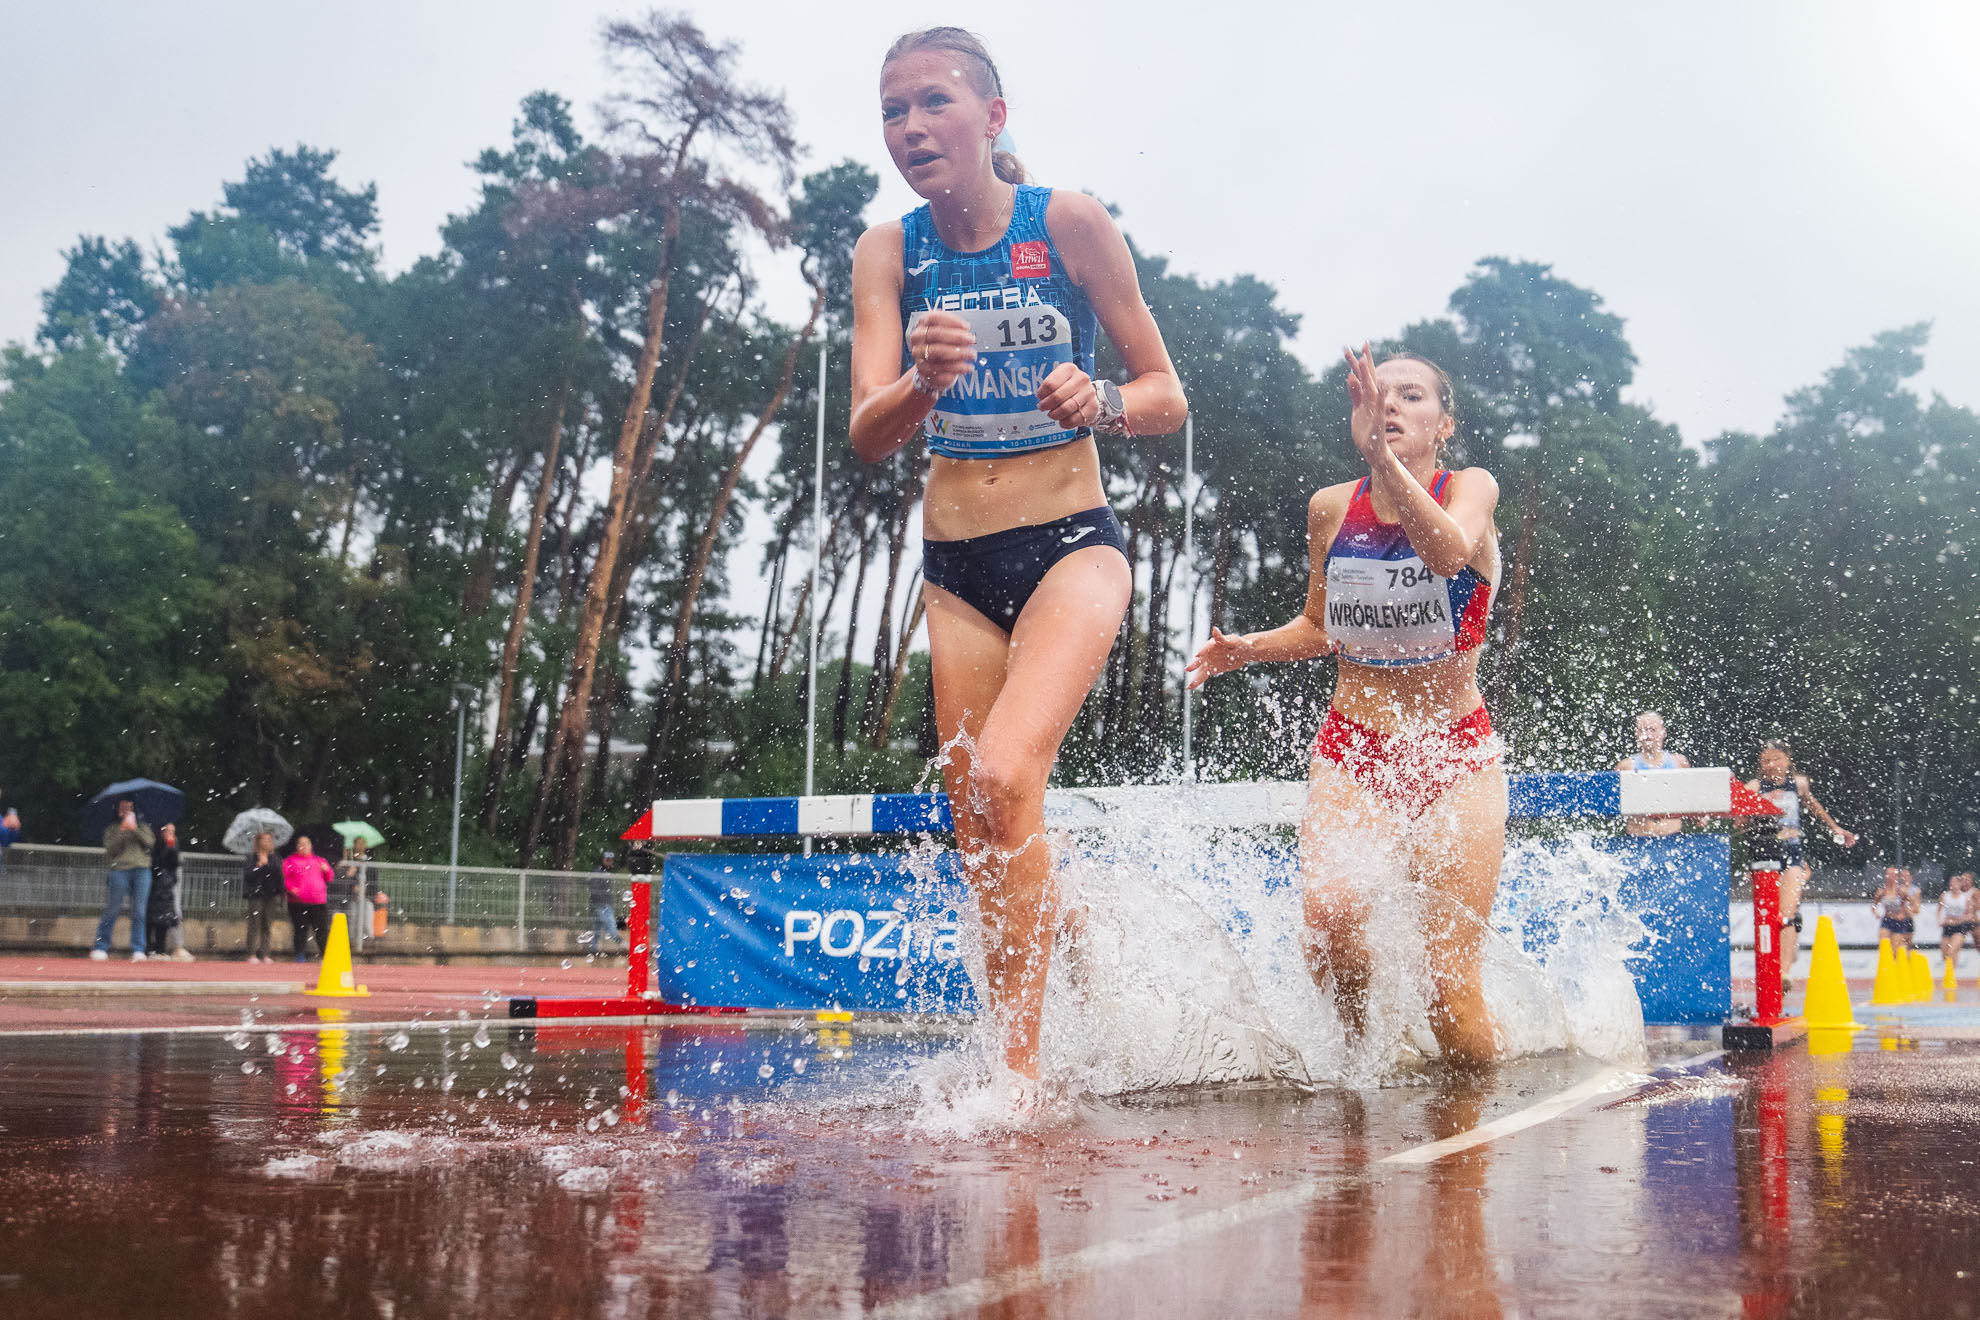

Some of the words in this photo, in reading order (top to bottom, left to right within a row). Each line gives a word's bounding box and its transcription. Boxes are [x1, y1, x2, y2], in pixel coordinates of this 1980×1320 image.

[1016, 251, 1044, 265] Anwil
[924, 285, 1043, 312] VECTRA
[996, 314, 1058, 347] 113
[942, 360, 1060, 401] MAŃSK
[1385, 566, 1434, 590] 784
[1329, 599, 1446, 629] WRÓBLEWSKA
[784, 909, 963, 959] POZna
